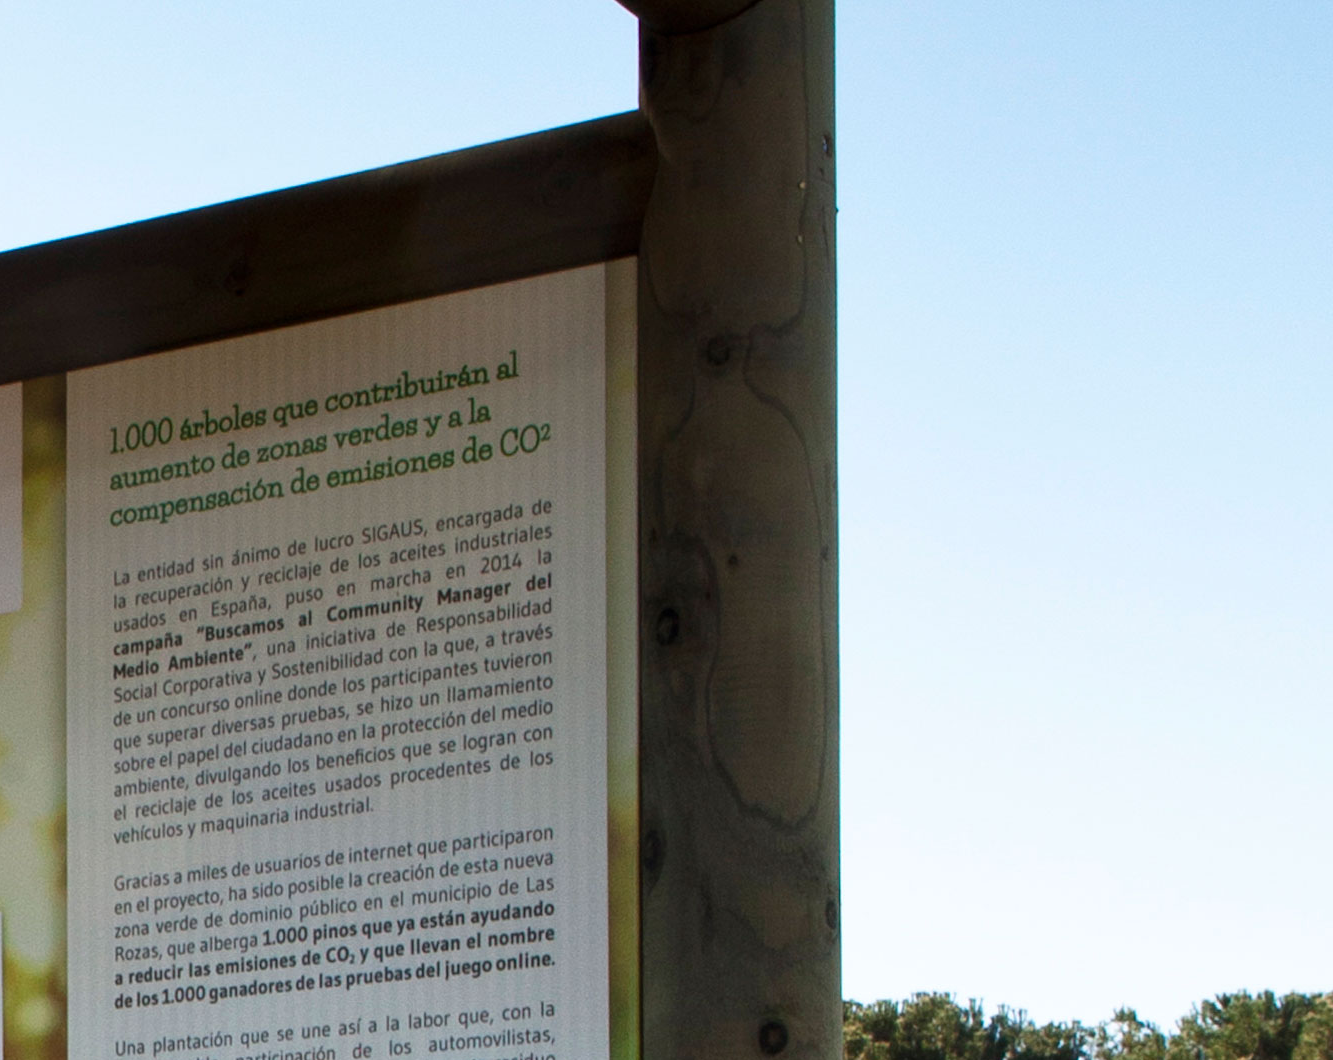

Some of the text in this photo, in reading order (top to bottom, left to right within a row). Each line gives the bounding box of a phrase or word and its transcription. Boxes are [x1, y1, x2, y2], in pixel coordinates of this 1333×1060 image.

[109, 349, 520, 455] 1.000 árboles que contribuirán al
[109, 396, 492, 491] aumento de zonas verdes y a la
[109, 477, 285, 527] compensación
[290, 466, 321, 495] de
[325, 449, 455, 489] emisiones
[461, 434, 494, 465] de
[113, 498, 553, 587] La entidad sin ánimo de lucro SIGAUS, encargada de
[113, 524, 553, 609] la recuperación y reciclaje de los aceites industriales
[113, 622, 553, 704] Social Corporativa y Sostenibilidad con la que, a través
[113, 796, 373, 845] vehículos y maquinaria industrial.
[113, 827, 554, 892] Gracias a miles de usuarios de internet que participaron
[115, 899, 556, 962] Rozas, que alberga 1.000 pinos que ya están ayudando
[114, 951, 556, 1010] de los 1.000 ganadores de las pruebas del juego online.
[352, 1042, 372, 1060] de
[389, 1039, 412, 1056] los
[428, 1029, 555, 1053] automovilistas,
